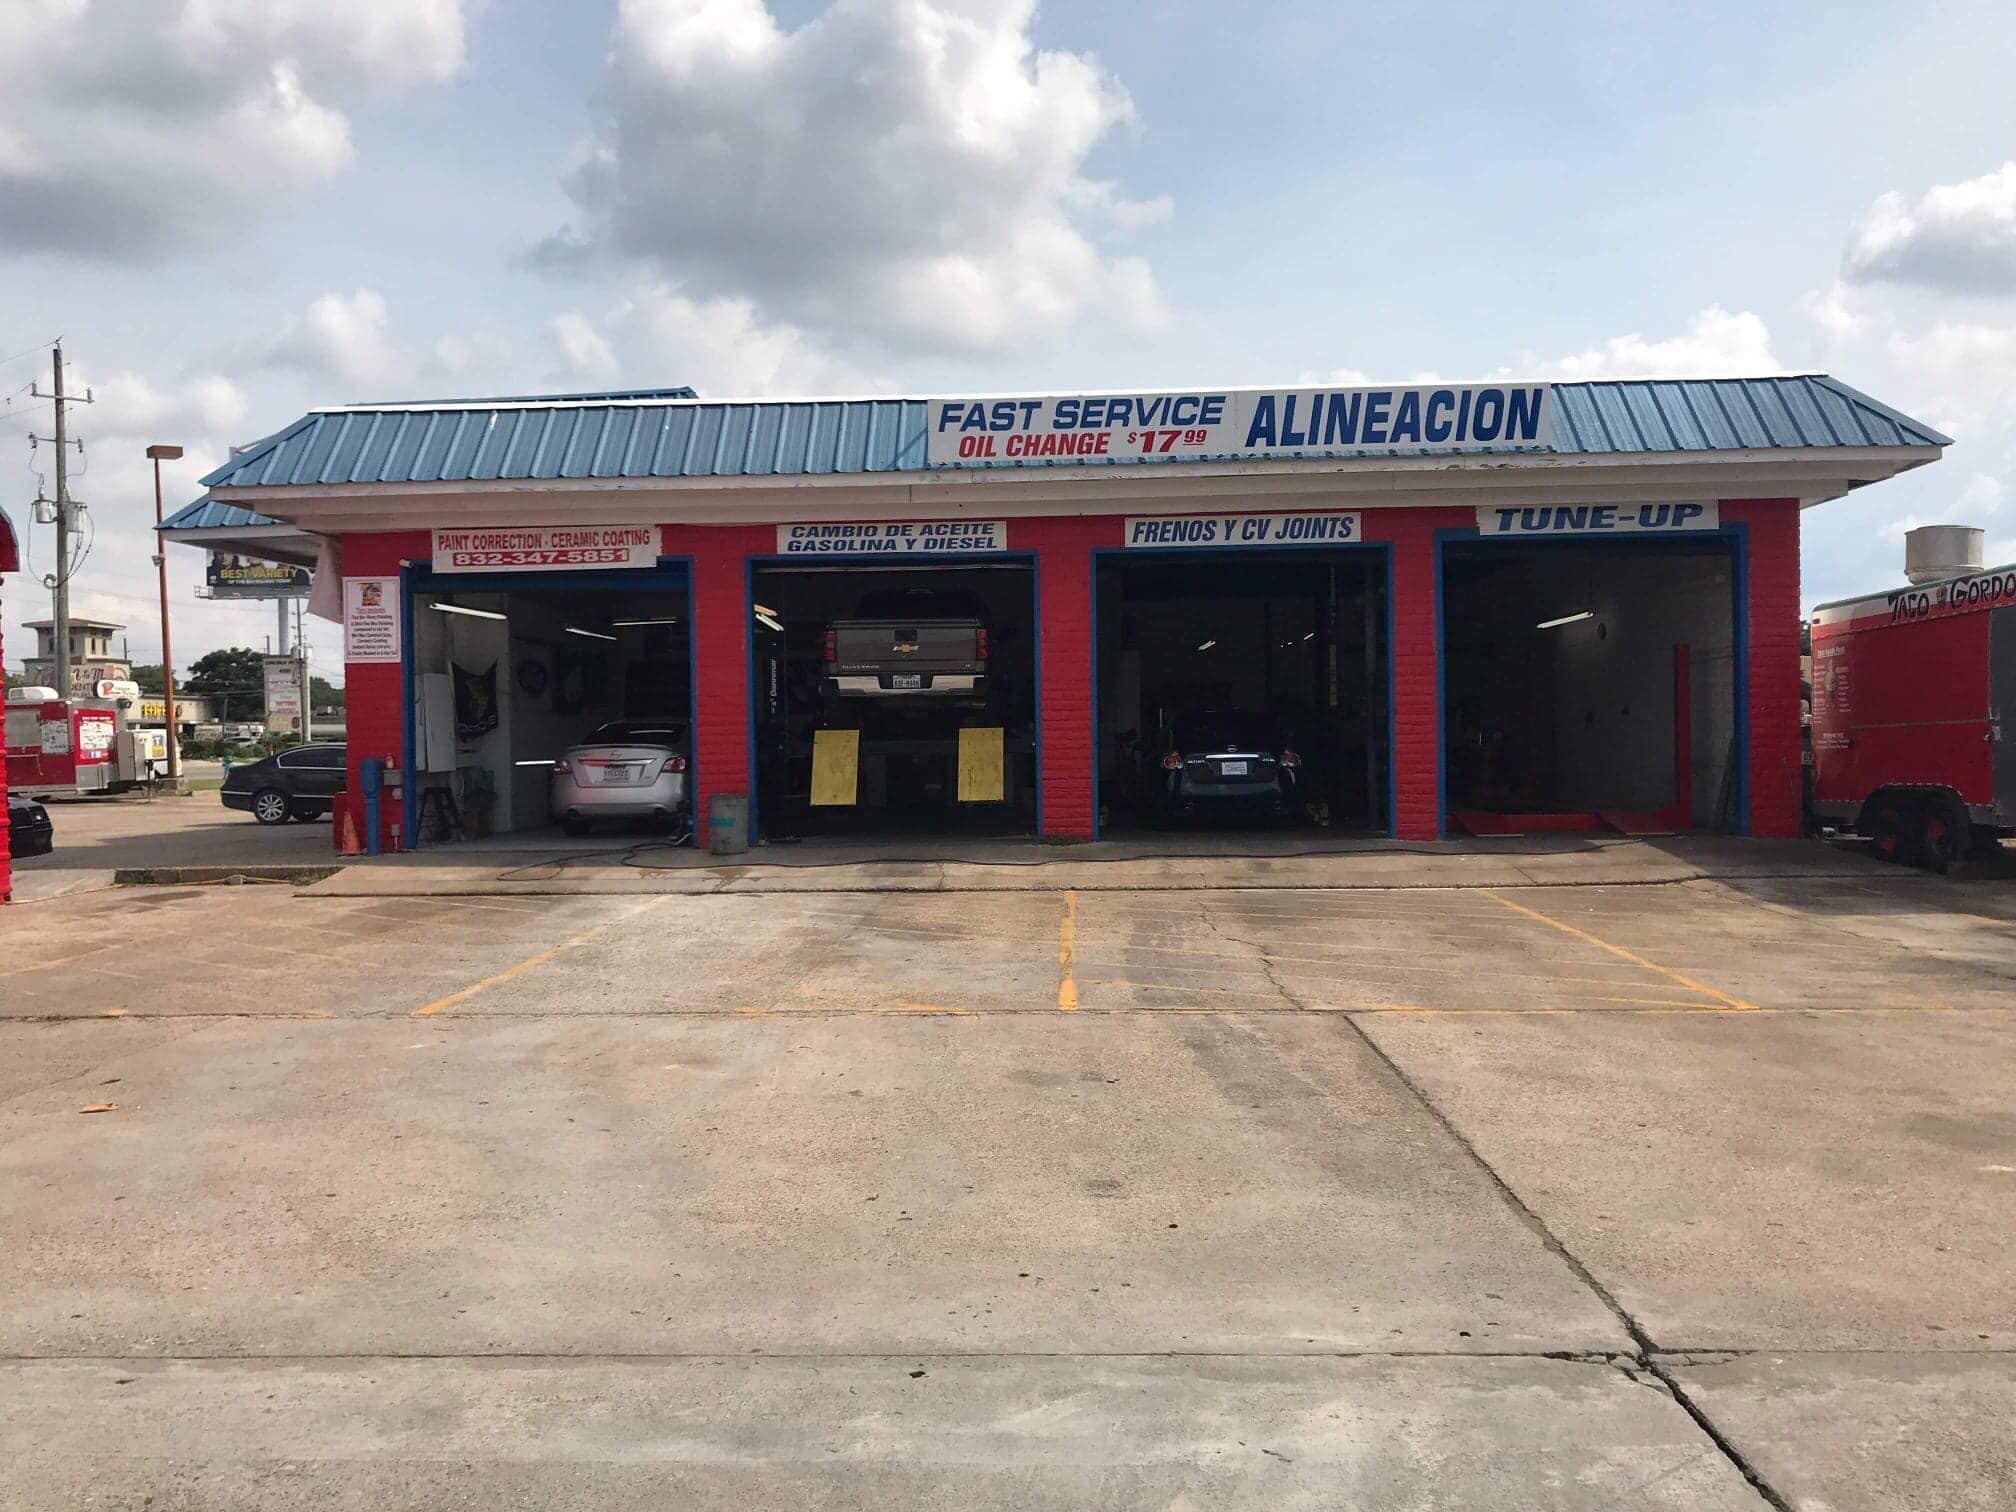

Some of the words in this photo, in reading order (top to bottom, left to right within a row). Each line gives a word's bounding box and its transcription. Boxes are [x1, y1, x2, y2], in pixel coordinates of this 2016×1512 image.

[938, 401, 1042, 433] FAST
[1053, 396, 1227, 429] SERVICE
[1244, 388, 1544, 448] ALINEACION
[958, 434, 997, 458] OIL
[1005, 431, 1112, 457] CHANGE
[791, 524, 877, 538] CAMBIO
[884, 523, 913, 537] DE
[919, 522, 995, 536] ACEITE
[1132, 519, 1217, 543] FRENOS
[1224, 519, 1238, 541] Y
[1241, 518, 1272, 541] CV
[1275, 516, 1354, 540] JOINTS
[1495, 503, 1704, 532] TUNE-UP
[438, 534, 469, 551] PAINT
[472, 532, 543, 550] CORRECTION
[551, 530, 600, 549] CERAMIC
[602, 529, 650, 548] COATING
[787, 538, 897, 552] GASOLINA
[904, 538, 918, 551] Y
[923, 537, 998, 550] DIESEL
[455, 550, 628, 566] 832-347-5851
[220, 568, 251, 579] BEST
[251, 567, 298, 579] VARIETY
[1888, 590, 1930, 621] TACO
[1951, 573, 2016, 609] GORDO
